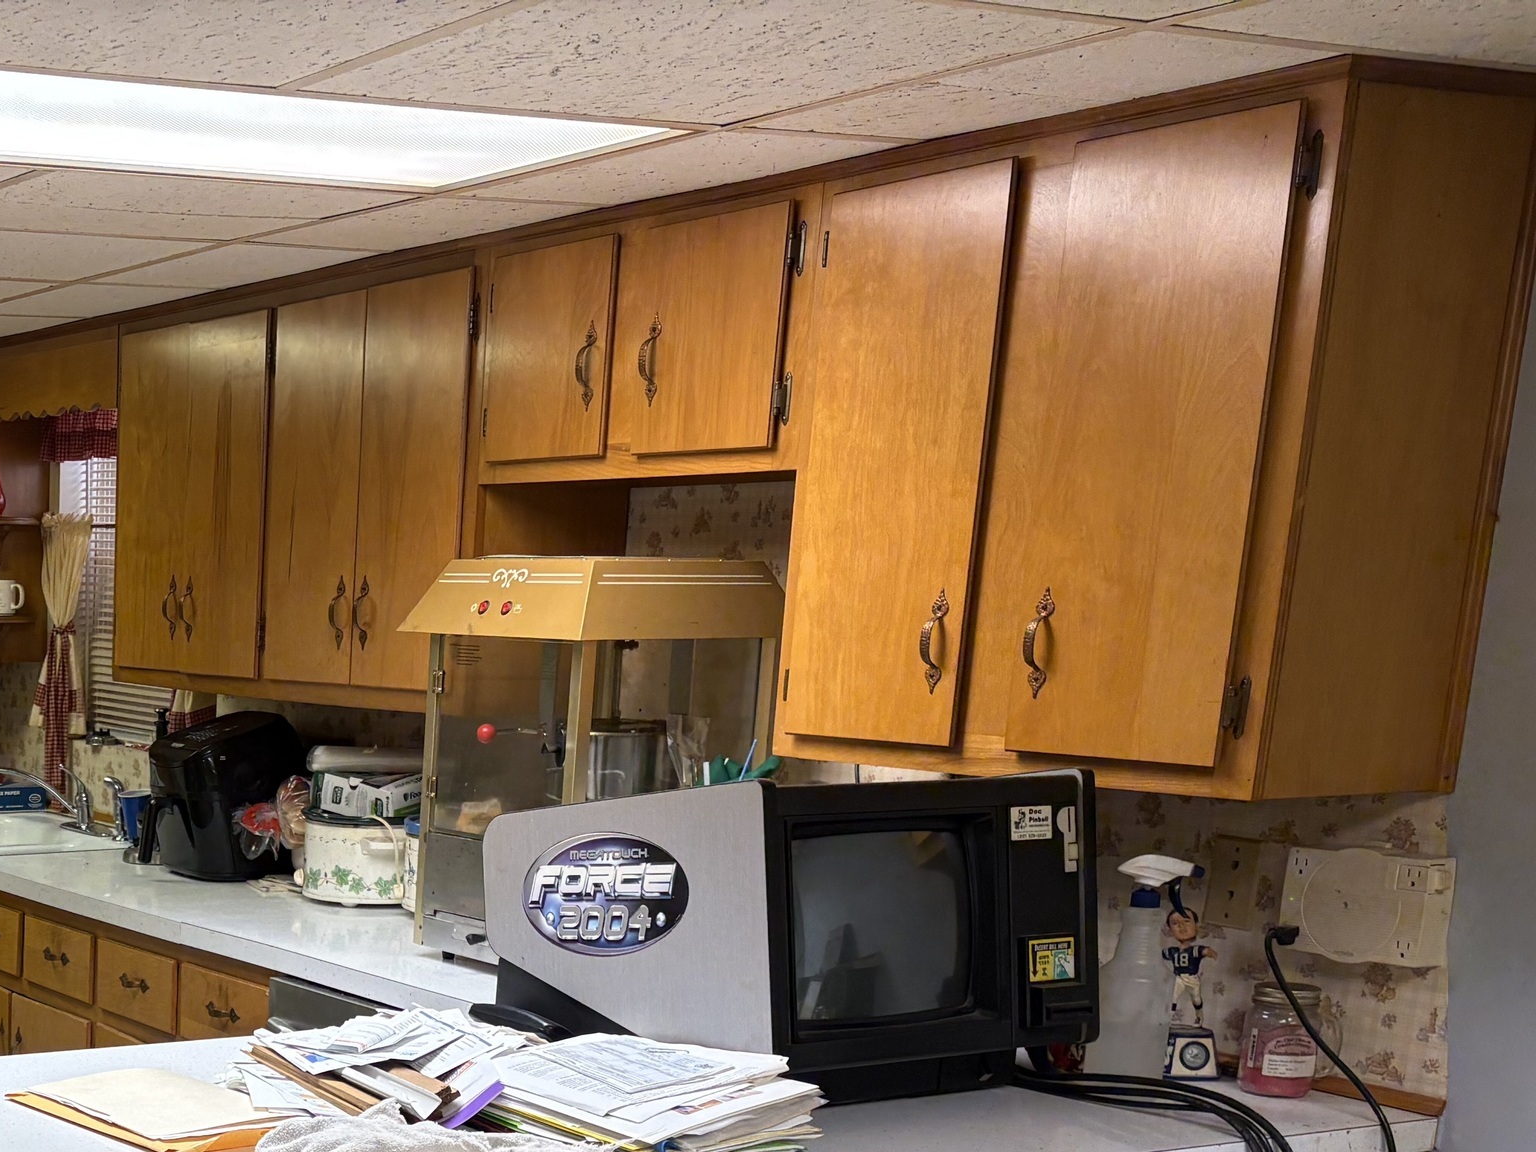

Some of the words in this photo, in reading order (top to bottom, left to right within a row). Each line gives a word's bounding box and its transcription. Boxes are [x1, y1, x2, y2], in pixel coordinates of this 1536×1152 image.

[569, 848, 649, 861] MEGATOUCH
[529, 863, 677, 909] FORCE
[557, 905, 652, 941] 2004
[1174, 953, 1189, 967] 18
